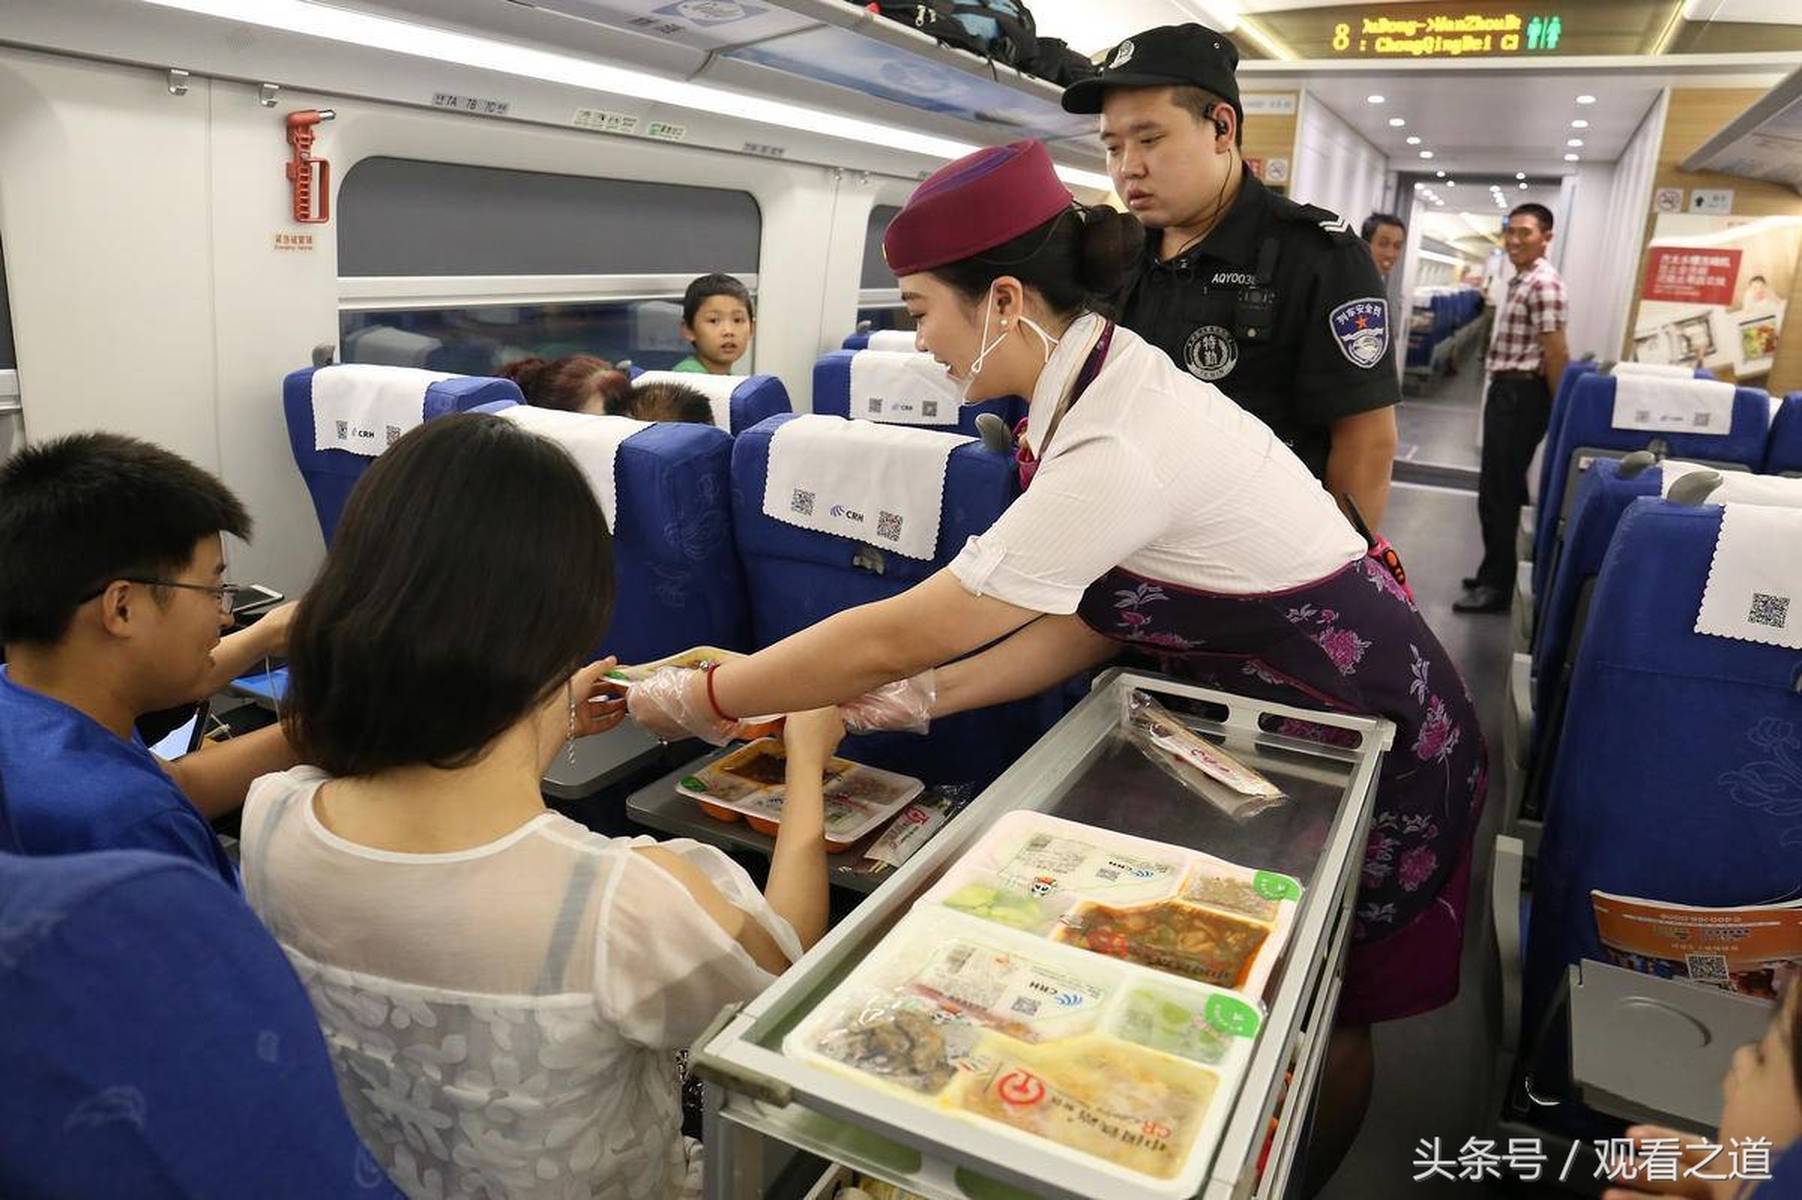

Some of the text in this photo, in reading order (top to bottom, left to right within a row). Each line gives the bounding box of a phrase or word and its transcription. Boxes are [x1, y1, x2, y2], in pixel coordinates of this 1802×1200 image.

[1333, 23, 1350, 51] 8
[1375, 35, 1492, 55] ChongQingBei
[1202, 335, 1218, 366] 特勤
[358, 430, 375, 438] CRH
[846, 510, 865, 523] CRH
[1029, 981, 1059, 995] CRH
